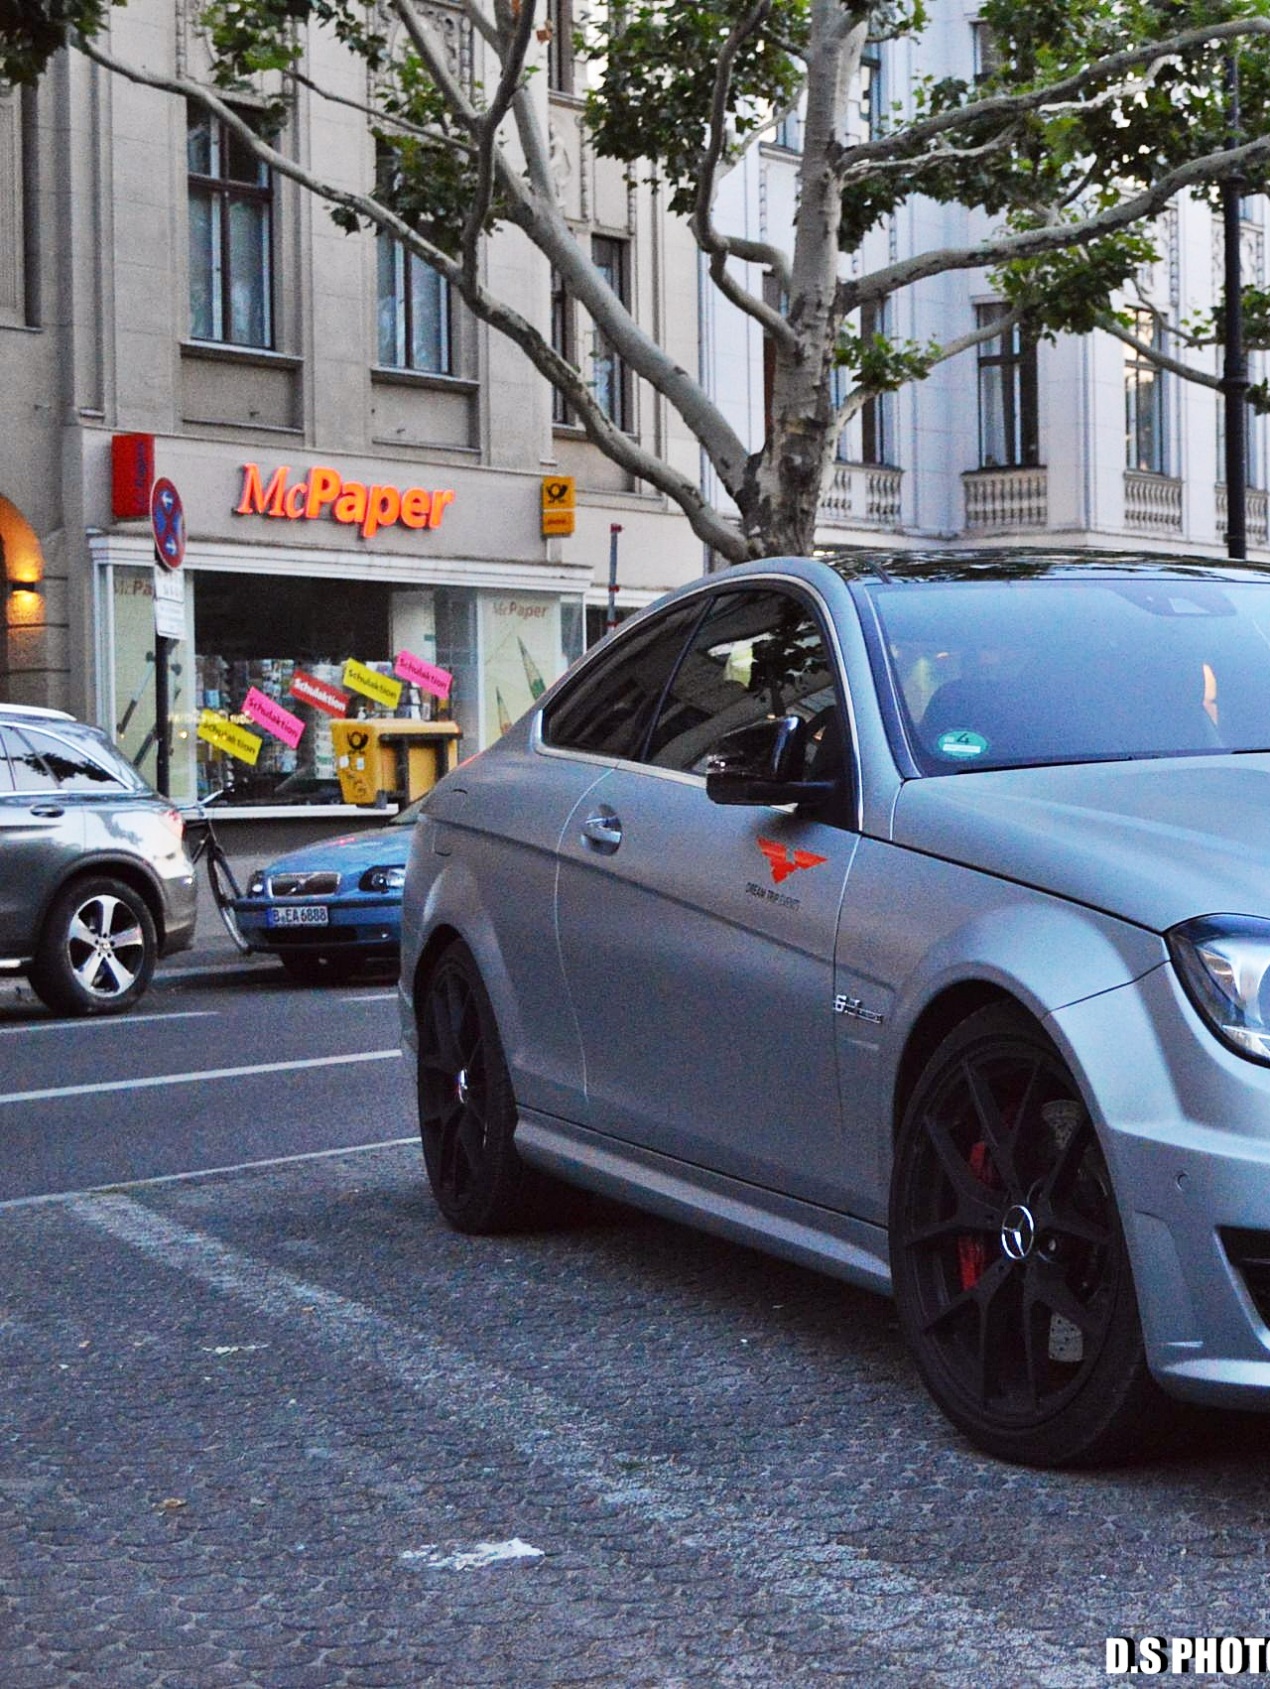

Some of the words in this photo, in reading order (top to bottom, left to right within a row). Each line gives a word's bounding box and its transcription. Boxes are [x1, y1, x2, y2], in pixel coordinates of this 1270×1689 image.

[237, 463, 455, 538] McPaper
[348, 668, 398, 698] Schulaktion
[398, 657, 448, 692] Schulaktion
[294, 677, 347, 712] Schulaktion
[248, 697, 299, 737] Schulaktion
[956, 732, 969, 745] 4
